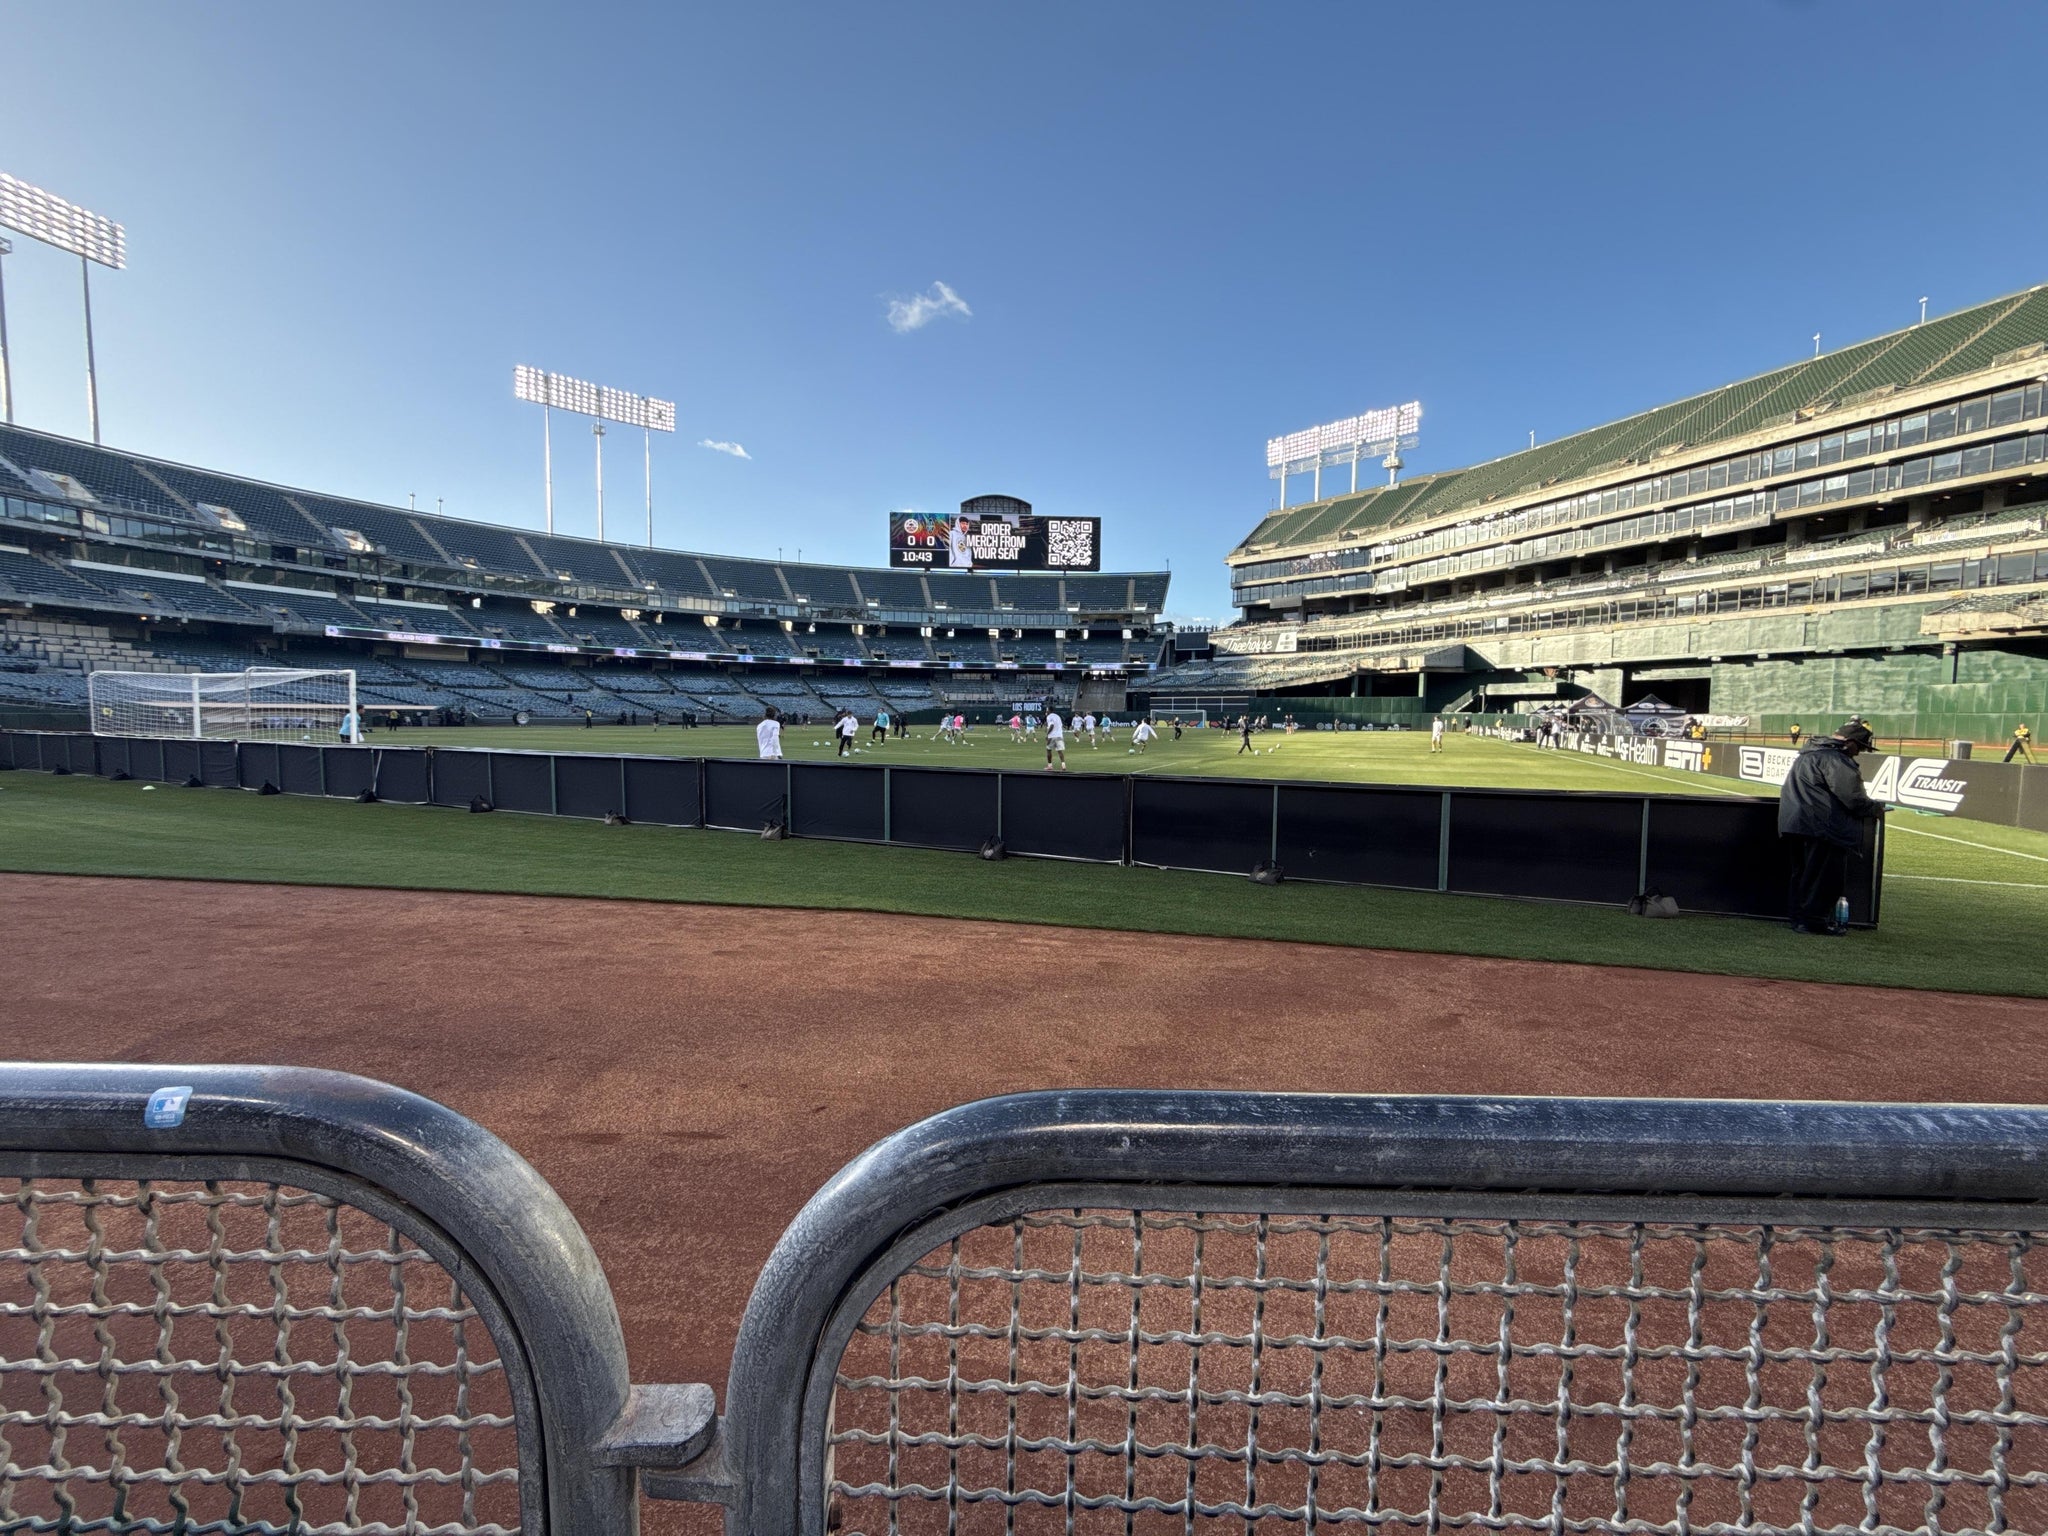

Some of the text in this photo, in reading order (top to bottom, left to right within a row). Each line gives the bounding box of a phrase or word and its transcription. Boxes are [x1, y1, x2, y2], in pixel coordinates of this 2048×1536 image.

[981, 523, 1011, 536] ORDER
[907, 536, 936, 546] 0 0
[966, 535, 1026, 548] MERCH FROM
[902, 551, 932, 562] 10:43
[972, 547, 1020, 560] YOUR SEAT
[1222, 635, 1273, 654] Treehouse
[1108, 720, 1131, 728] nthem
[1629, 736, 1658, 766] Health
[1767, 754, 1796, 767] BECKE
[1766, 766, 1788, 778] BOAR
[1914, 776, 1968, 793] TRANSIT
